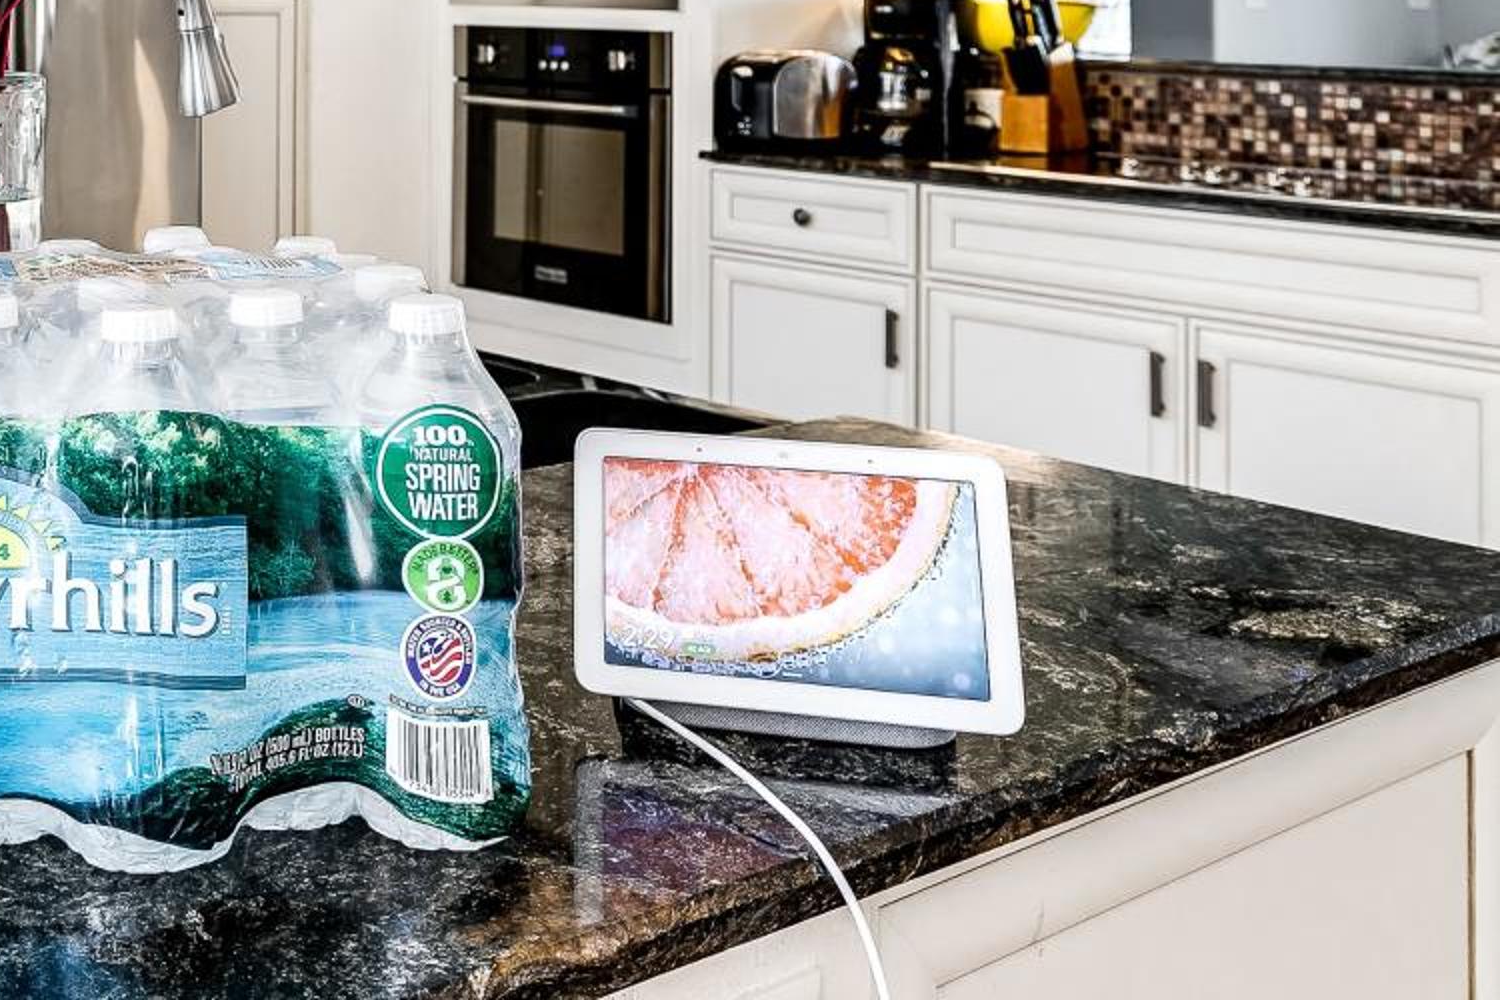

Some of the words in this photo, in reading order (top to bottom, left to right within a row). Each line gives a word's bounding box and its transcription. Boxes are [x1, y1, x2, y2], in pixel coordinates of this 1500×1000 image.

[413, 448, 473, 462] NATURAL
[405, 463, 481, 491] SPRING
[408, 492, 479, 521] WATER
[315, 726, 365, 743] BOTTLES
